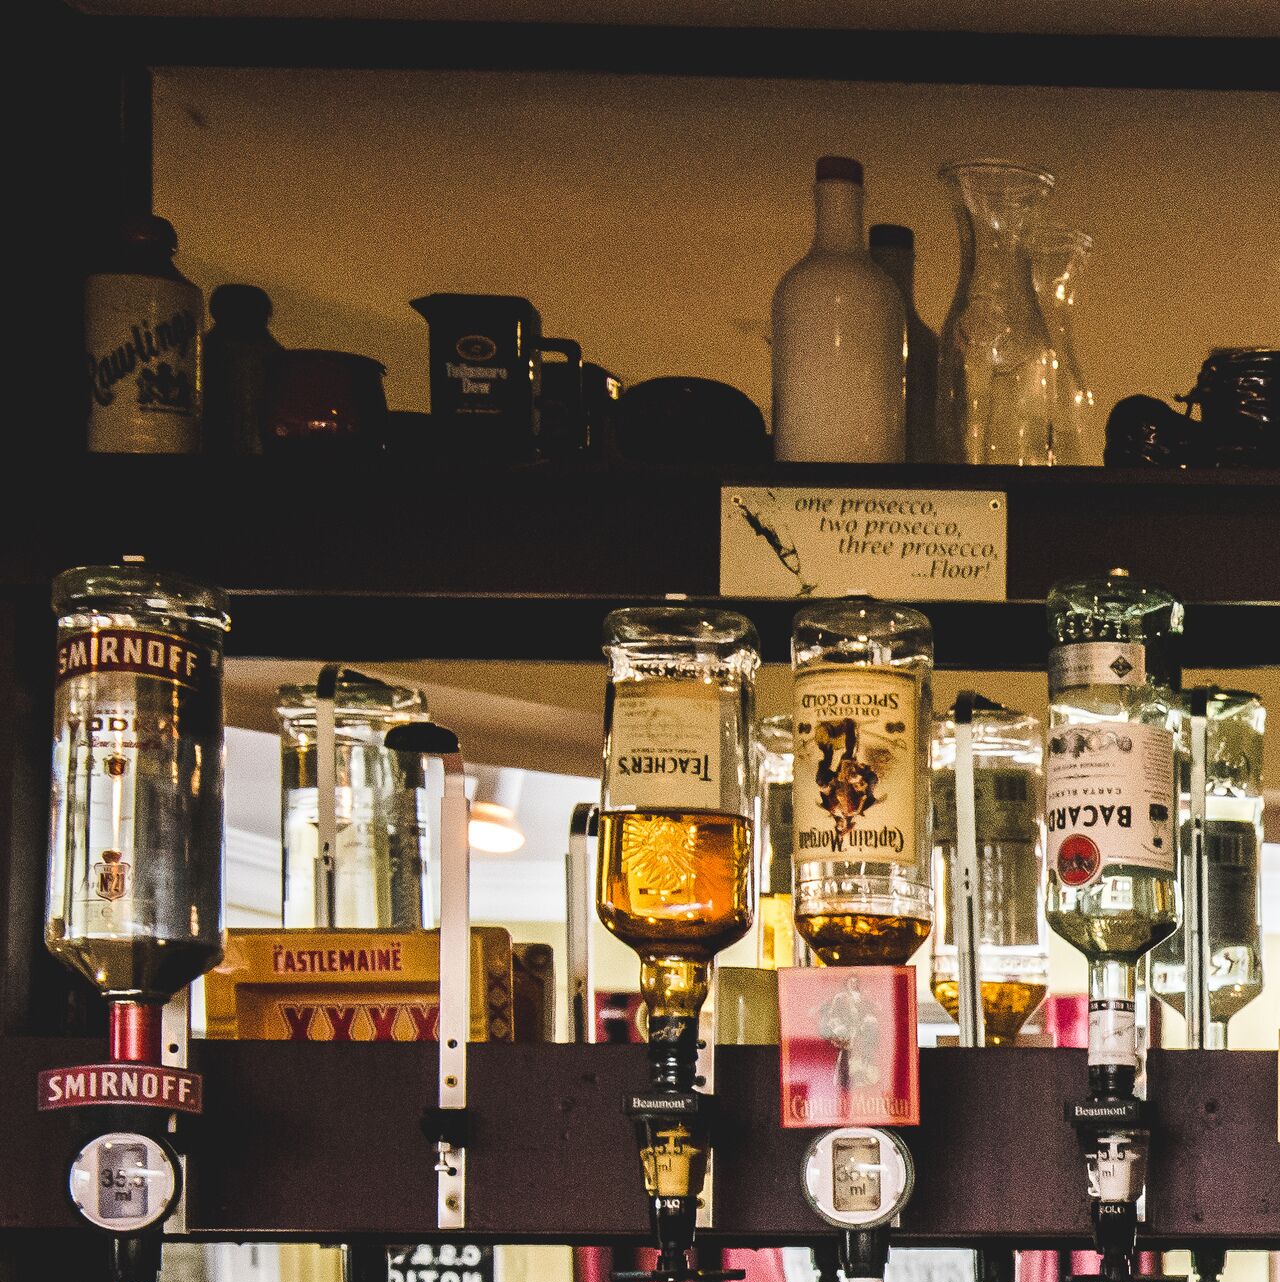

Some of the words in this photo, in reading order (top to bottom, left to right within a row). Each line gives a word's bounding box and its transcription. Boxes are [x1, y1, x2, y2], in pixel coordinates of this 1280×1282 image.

[794, 498, 834, 512] one
[837, 498, 937, 517] prosecco,
[819, 516, 857, 533] two
[864, 519, 962, 538] prosecco,
[838, 537, 894, 556] three
[901, 541, 999, 560] prosecco,
[58, 636, 198, 677] SMIRNOFF
[802, 693, 838, 709] GOLD
[841, 693, 899, 710] SPICED
[816, 707, 880, 717] ORIGINAL
[618, 754, 712, 781] TEACHER'S
[1048, 805, 1132, 832] BACARD
[798, 828, 847, 853] Morgan
[850, 826, 904, 853] Captain
[47, 1071, 193, 1104] SMIRNOFF
[632, 1098, 685, 1109] Beaumont
[1075, 1105, 1126, 1116] Beaumont
[1102, 1165, 1115, 1177] ml
[115, 1190, 132, 1202] ml
[850, 1183, 866, 1196] ml
